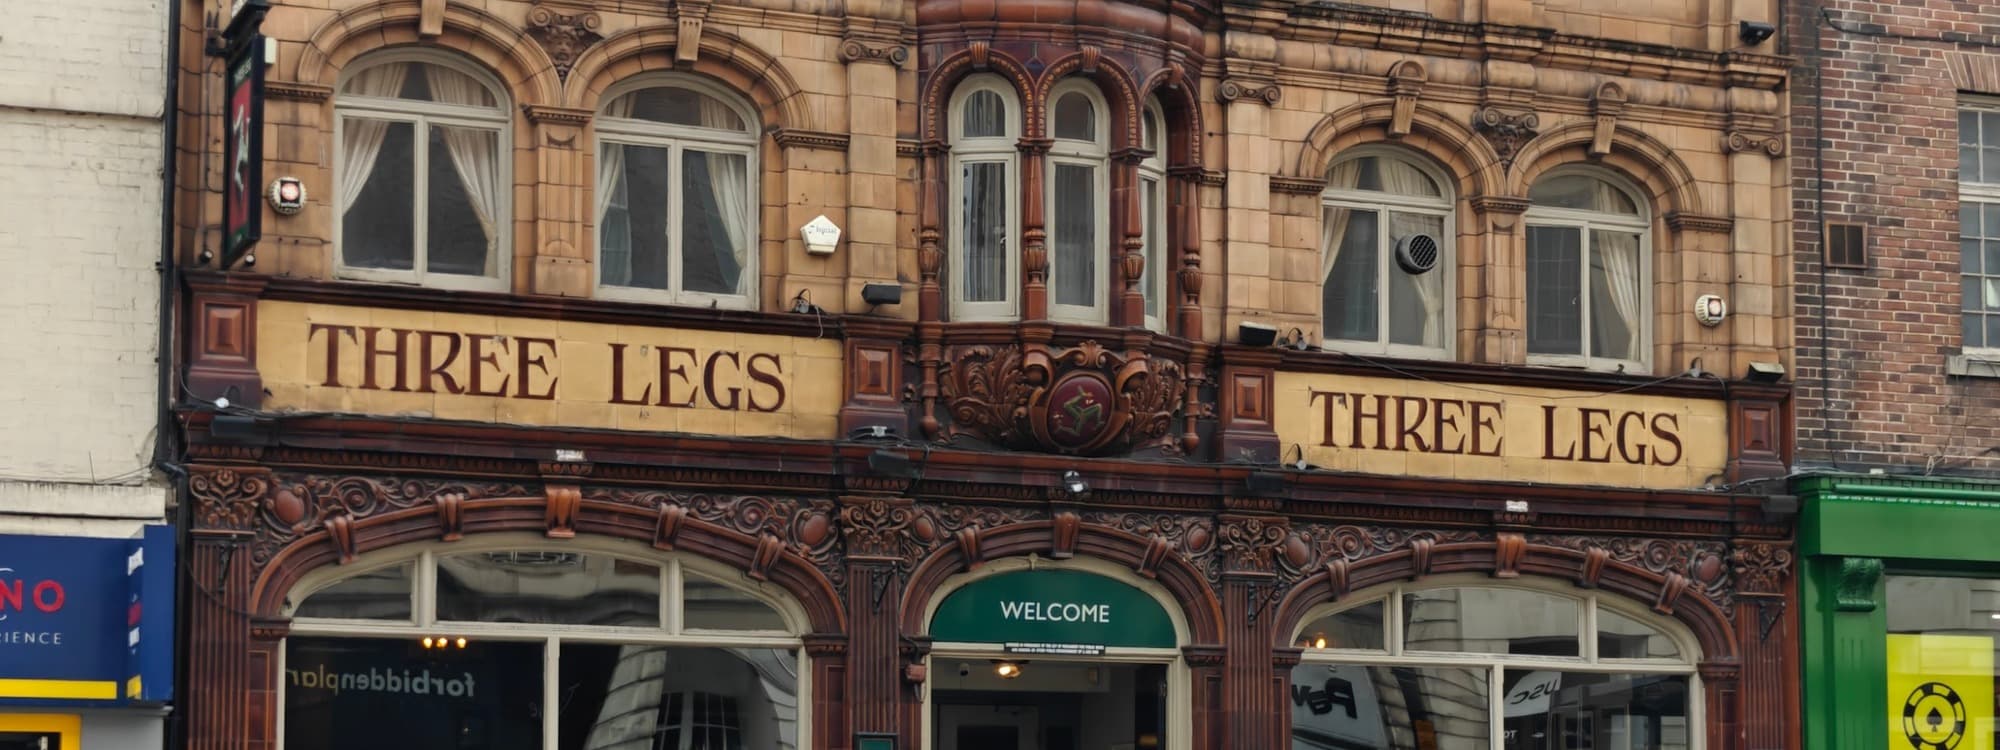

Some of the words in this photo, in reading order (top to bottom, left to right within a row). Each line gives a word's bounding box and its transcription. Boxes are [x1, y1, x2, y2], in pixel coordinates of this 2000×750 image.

[308, 323, 558, 401] THREE
[607, 342, 786, 413] LEGS
[1309, 390, 1503, 457] THREE
[1540, 404, 1683, 467] LEGS
[0, 578, 65, 613] NO
[1000, 600, 1110, 623] WELCOME
[0, 631, 62, 645] IENCE
